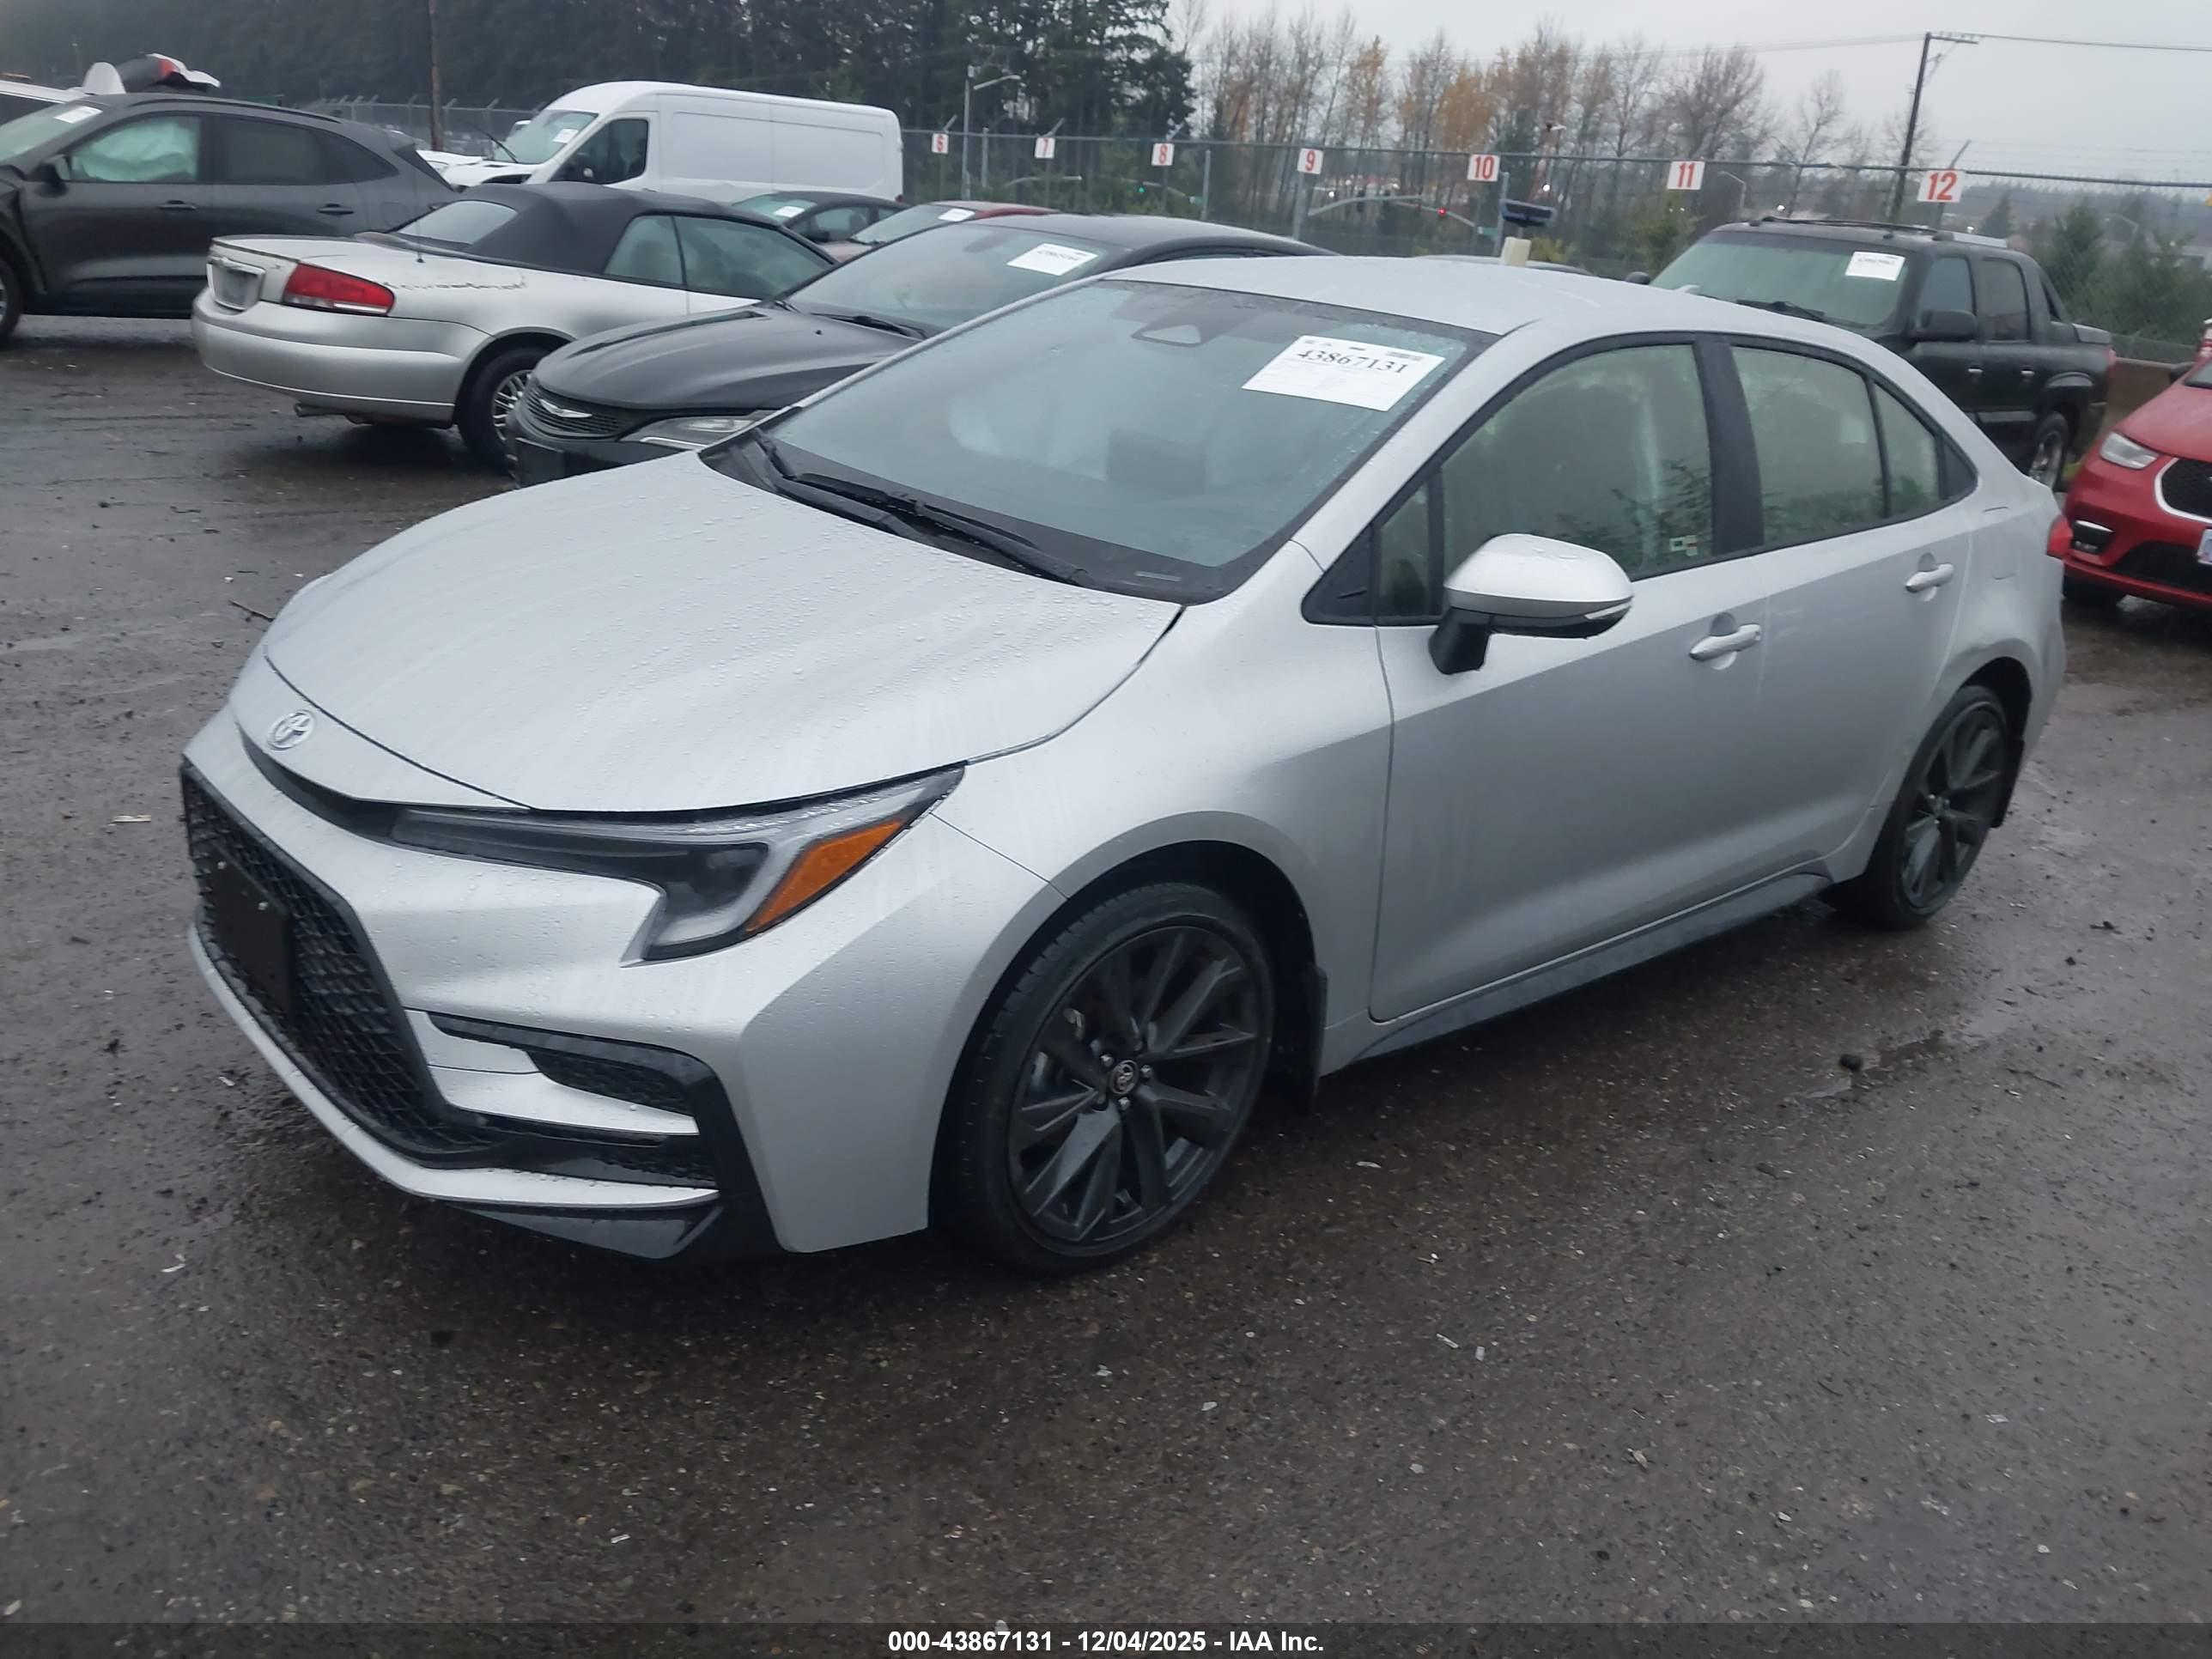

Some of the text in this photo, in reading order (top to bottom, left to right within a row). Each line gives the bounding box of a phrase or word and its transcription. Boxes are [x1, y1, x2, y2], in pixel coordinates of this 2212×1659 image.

[1158, 144, 1169, 165] 8
[1305, 150, 1316, 172] 9
[1474, 155, 1495, 179] 10
[1677, 162, 1697, 188] 11
[1927, 172, 1958, 201] 12
[1297, 349, 1409, 374] 43867131
